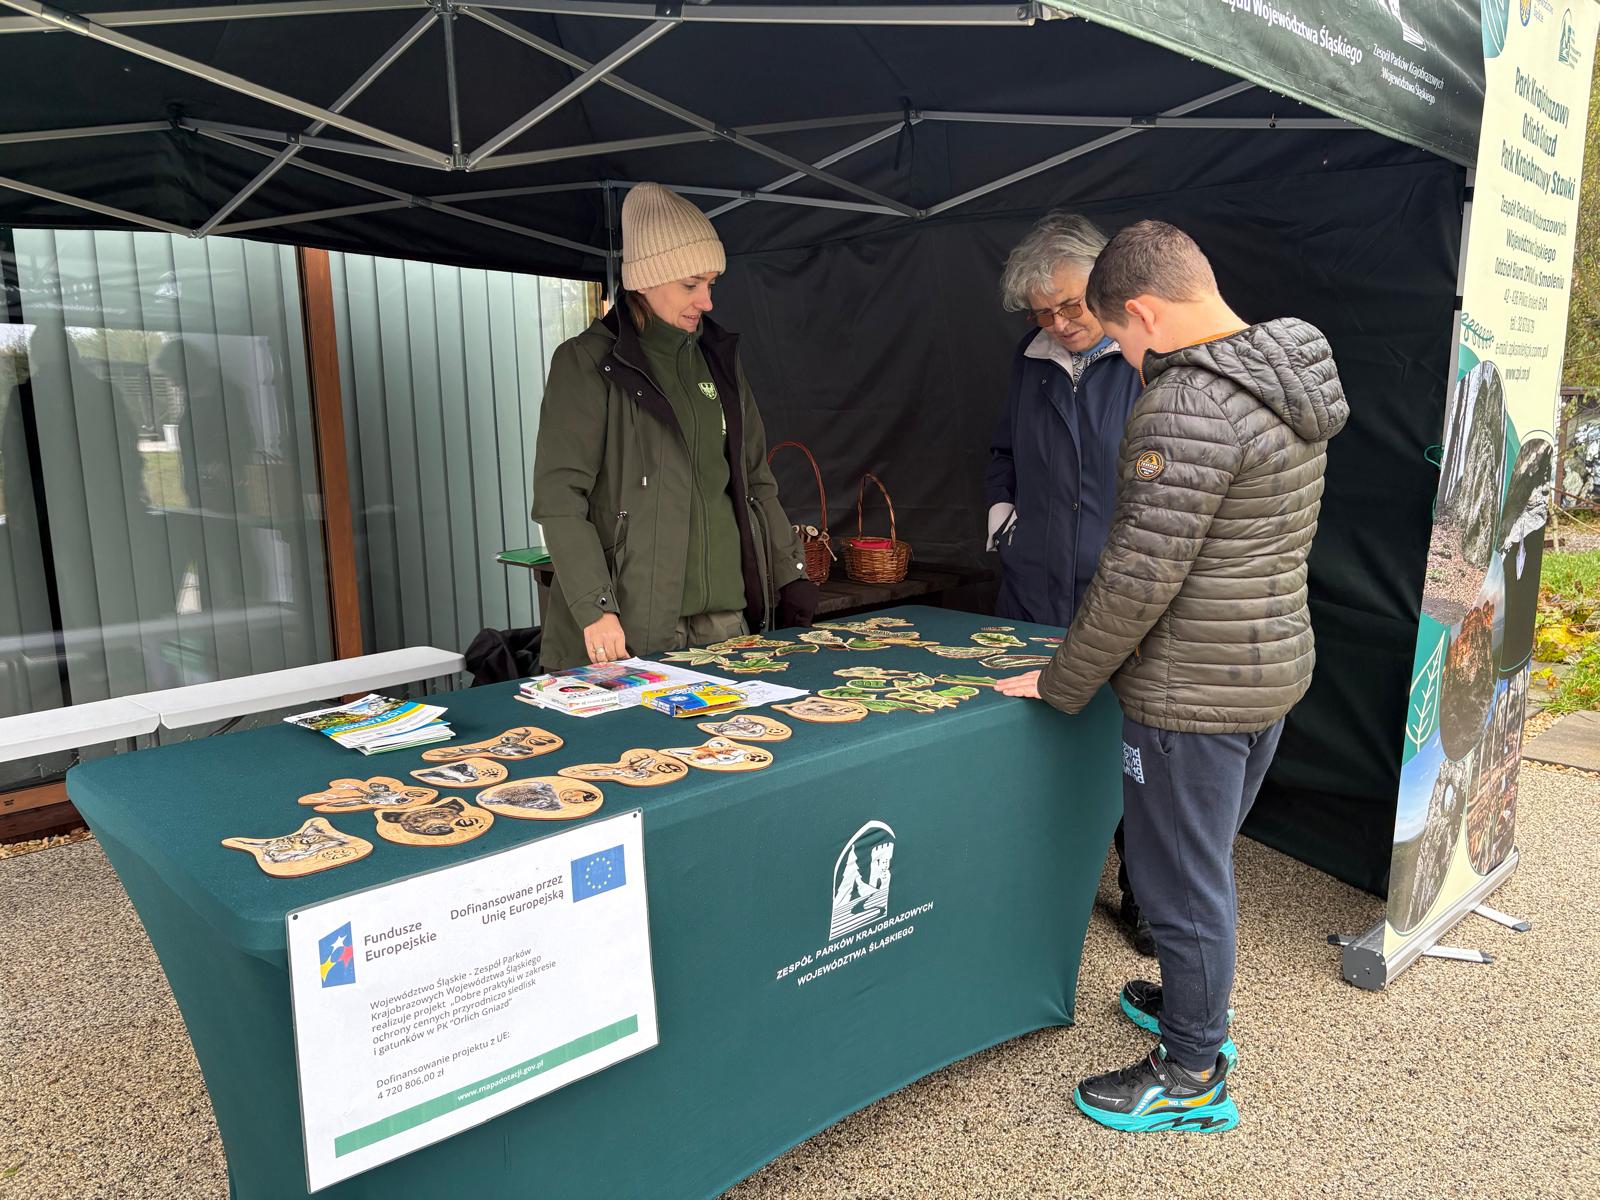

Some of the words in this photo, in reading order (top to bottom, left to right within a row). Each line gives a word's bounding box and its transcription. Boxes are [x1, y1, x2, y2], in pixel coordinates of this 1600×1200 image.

[1320, 25, 1362, 65] Śląskiego
[1373, 43, 1390, 62] Zespół
[1391, 52, 1409, 72] Parków
[1515, 66, 1531, 102] Park
[1522, 112, 1540, 146] Orlich
[1501, 138, 1515, 173] Park
[1551, 170, 1576, 201] Stawki
[450, 886, 533, 920] Dofinansowane
[536, 875, 563, 894] przez
[482, 909, 506, 925] Unię
[509, 889, 564, 916] Europejską
[364, 921, 423, 946] Fundusze
[365, 931, 437, 962] Europejskie
[776, 954, 813, 980] ZESPÓŁ
[815, 935, 854, 960] PARKÓW
[855, 901, 934, 942] KRAJOBRAZOWYCH
[797, 947, 866, 986] WOJEWÓDZTWA
[868, 925, 914, 952] ŚLĄSKIEGO
[370, 984, 435, 1010] Województwo
[437, 972, 467, 989] Śląskie
[474, 959, 501, 977] Zespół
[502, 948, 532, 966] Parków
[371, 990, 444, 1022] Krajobrazowych
[447, 970, 505, 996] Województwa
[506, 954, 541, 975] Śląskiego
[372, 1013, 412, 1033] realizuje
[413, 1001, 446, 1021] projekt
[450, 988, 481, 1007] „Dobre
[483, 975, 515, 996] praktyki
[525, 959, 557, 978] zakresie
[372, 1024, 412, 1045] ochrony
[413, 1011, 450, 1030] cennych
[452, 991, 507, 1018] przyrodniczo
[508, 977, 537, 997] siedlisk
[376, 1055, 450, 1089] Dofinansowanie
[452, 1042, 489, 1062] projektu
[490, 1038, 496, 1046] z
[496, 1031, 511, 1043] UE:
[378, 1031, 424, 1057] gatunków
[437, 1020, 449, 1032] PK
[377, 1091, 383, 1101] 4
[385, 1084, 403, 1097] 720
[404, 1073, 435, 1092] 806,00
[437, 1068, 445, 1079] zł
[457, 1059, 544, 1102] www.mapadotacji.gov.pl
